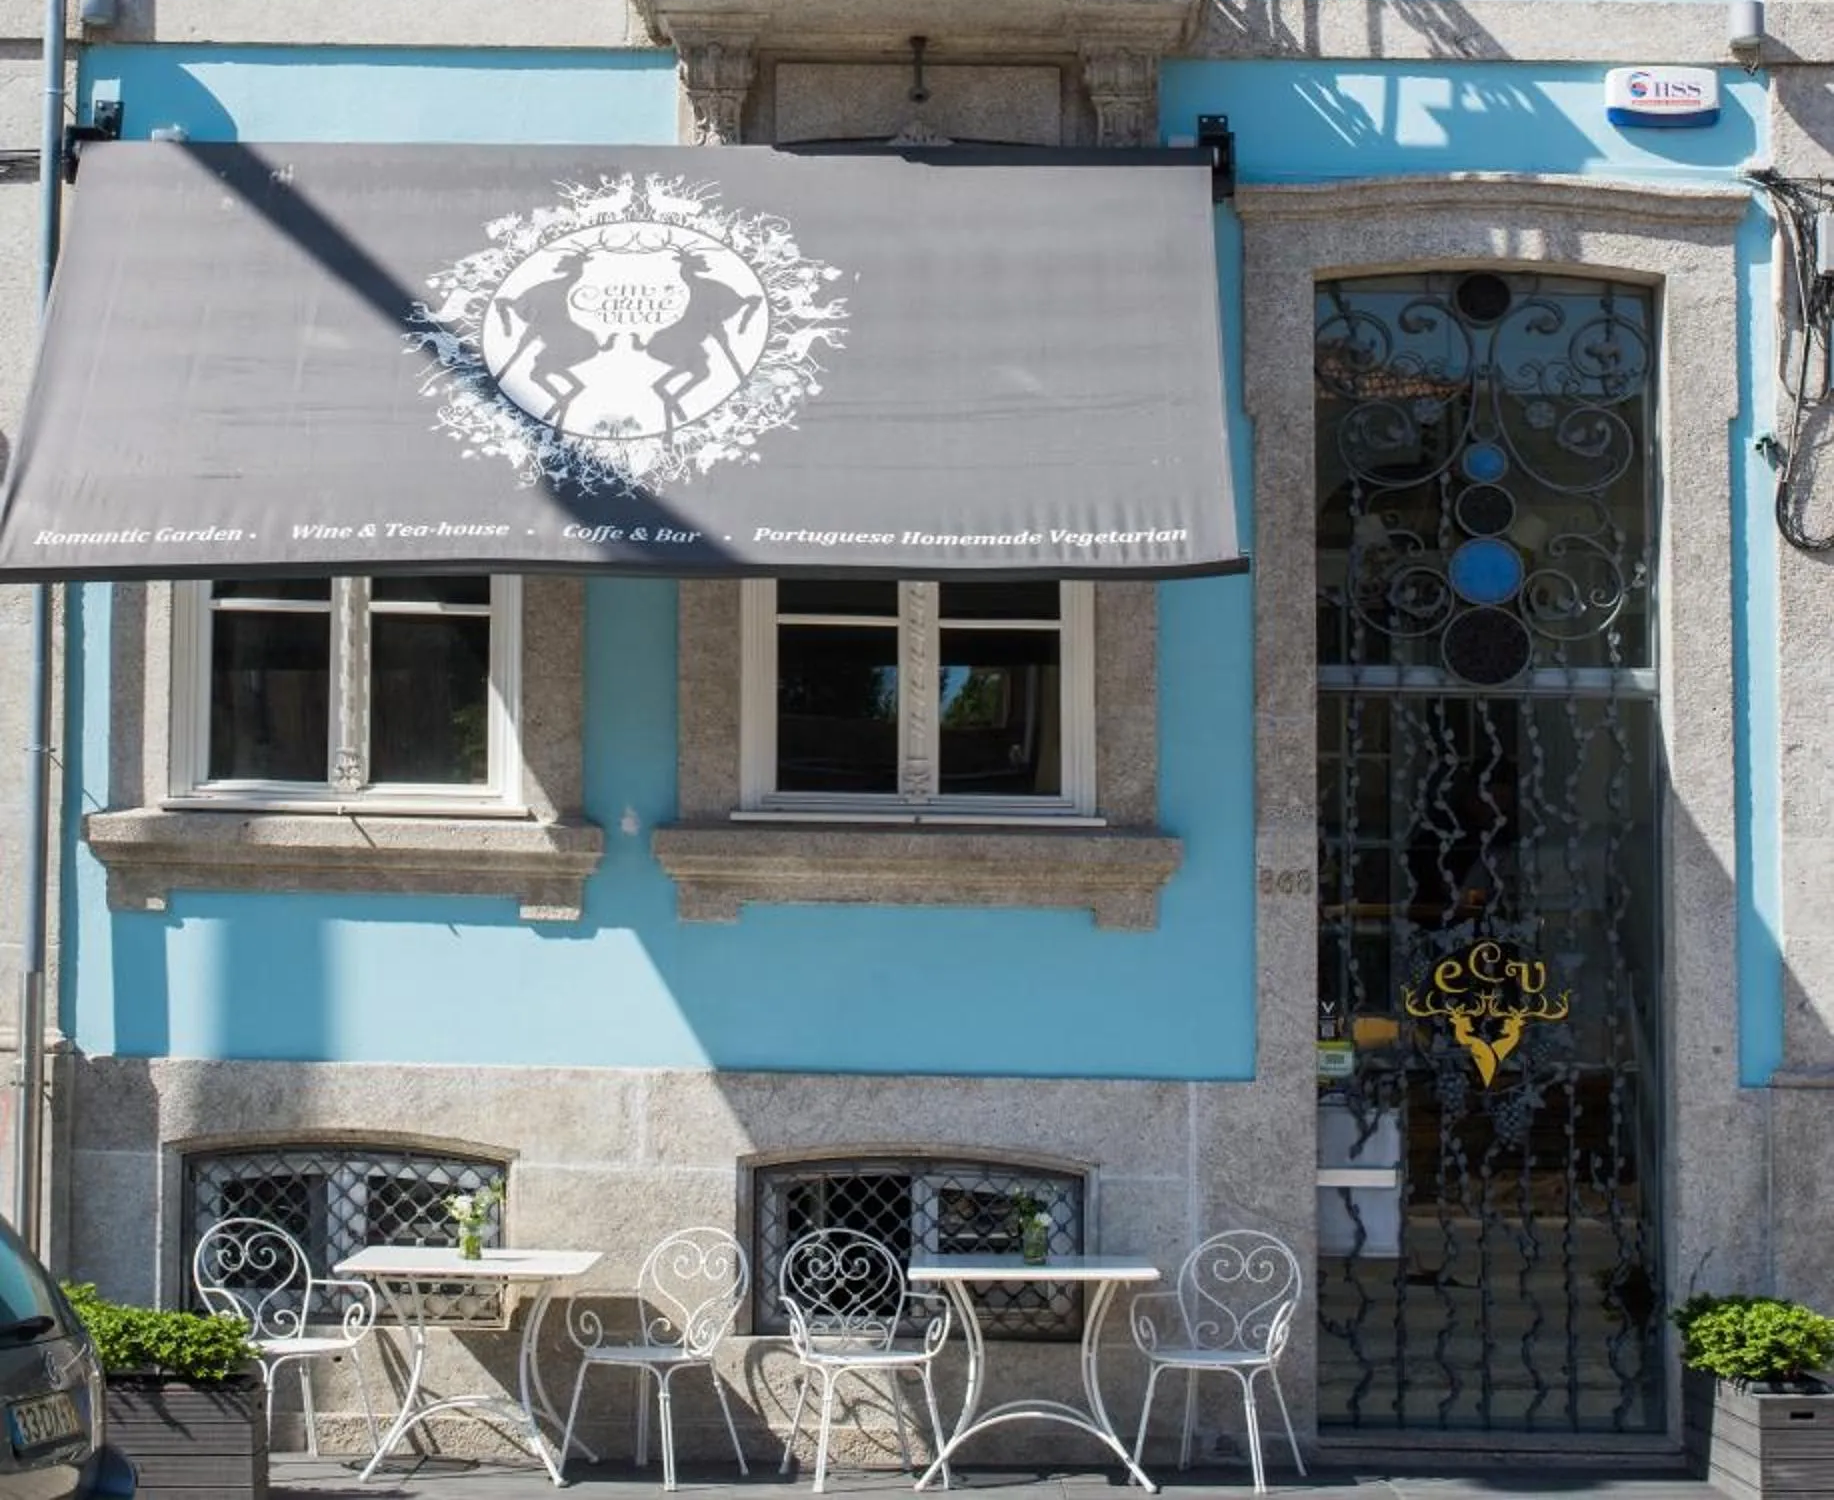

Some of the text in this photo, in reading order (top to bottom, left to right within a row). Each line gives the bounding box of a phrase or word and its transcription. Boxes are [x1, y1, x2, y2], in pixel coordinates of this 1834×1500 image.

[33, 525, 243, 545] Romantic Garden
[292, 520, 511, 540] Wine & Tea-house
[562, 523, 702, 543] Coffe & Bar
[752, 527, 1188, 547] Portuguese Homemade Vegetarian
